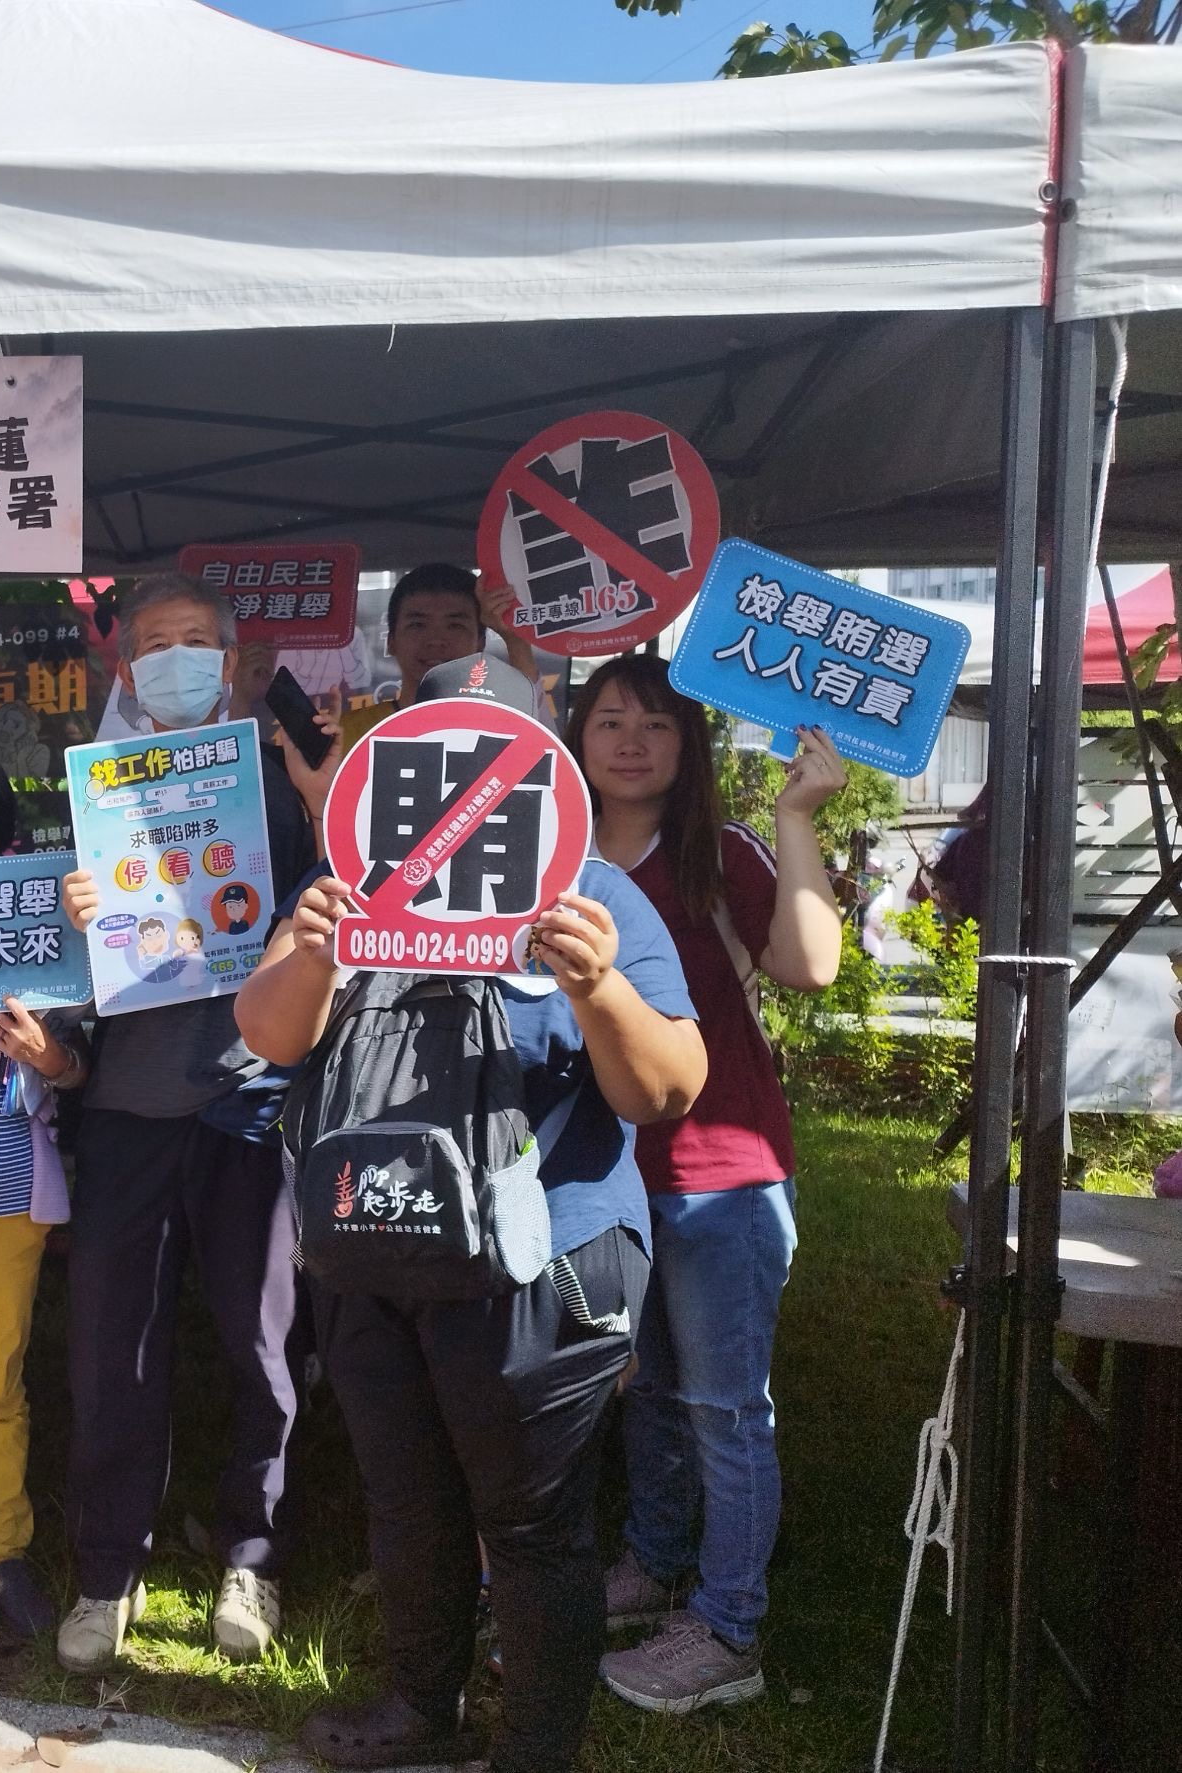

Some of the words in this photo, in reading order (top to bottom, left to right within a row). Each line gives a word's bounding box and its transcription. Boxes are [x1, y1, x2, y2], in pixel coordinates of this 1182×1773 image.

[202, 560, 334, 587] 自由民主
[223, 593, 331, 620] 淨選舉
[737, 573, 930, 676] 檢舉賄選
[56, 626, 81, 640] #4
[715, 627, 913, 726] 人人有責
[129, 818, 220, 849] 求職陷阱多
[359, 735, 554, 915] 賄
[123, 859, 149, 886] 停
[166, 850, 192, 879] 看
[211, 845, 236, 873] 聽
[350, 929, 509, 966] 0800-024-099
